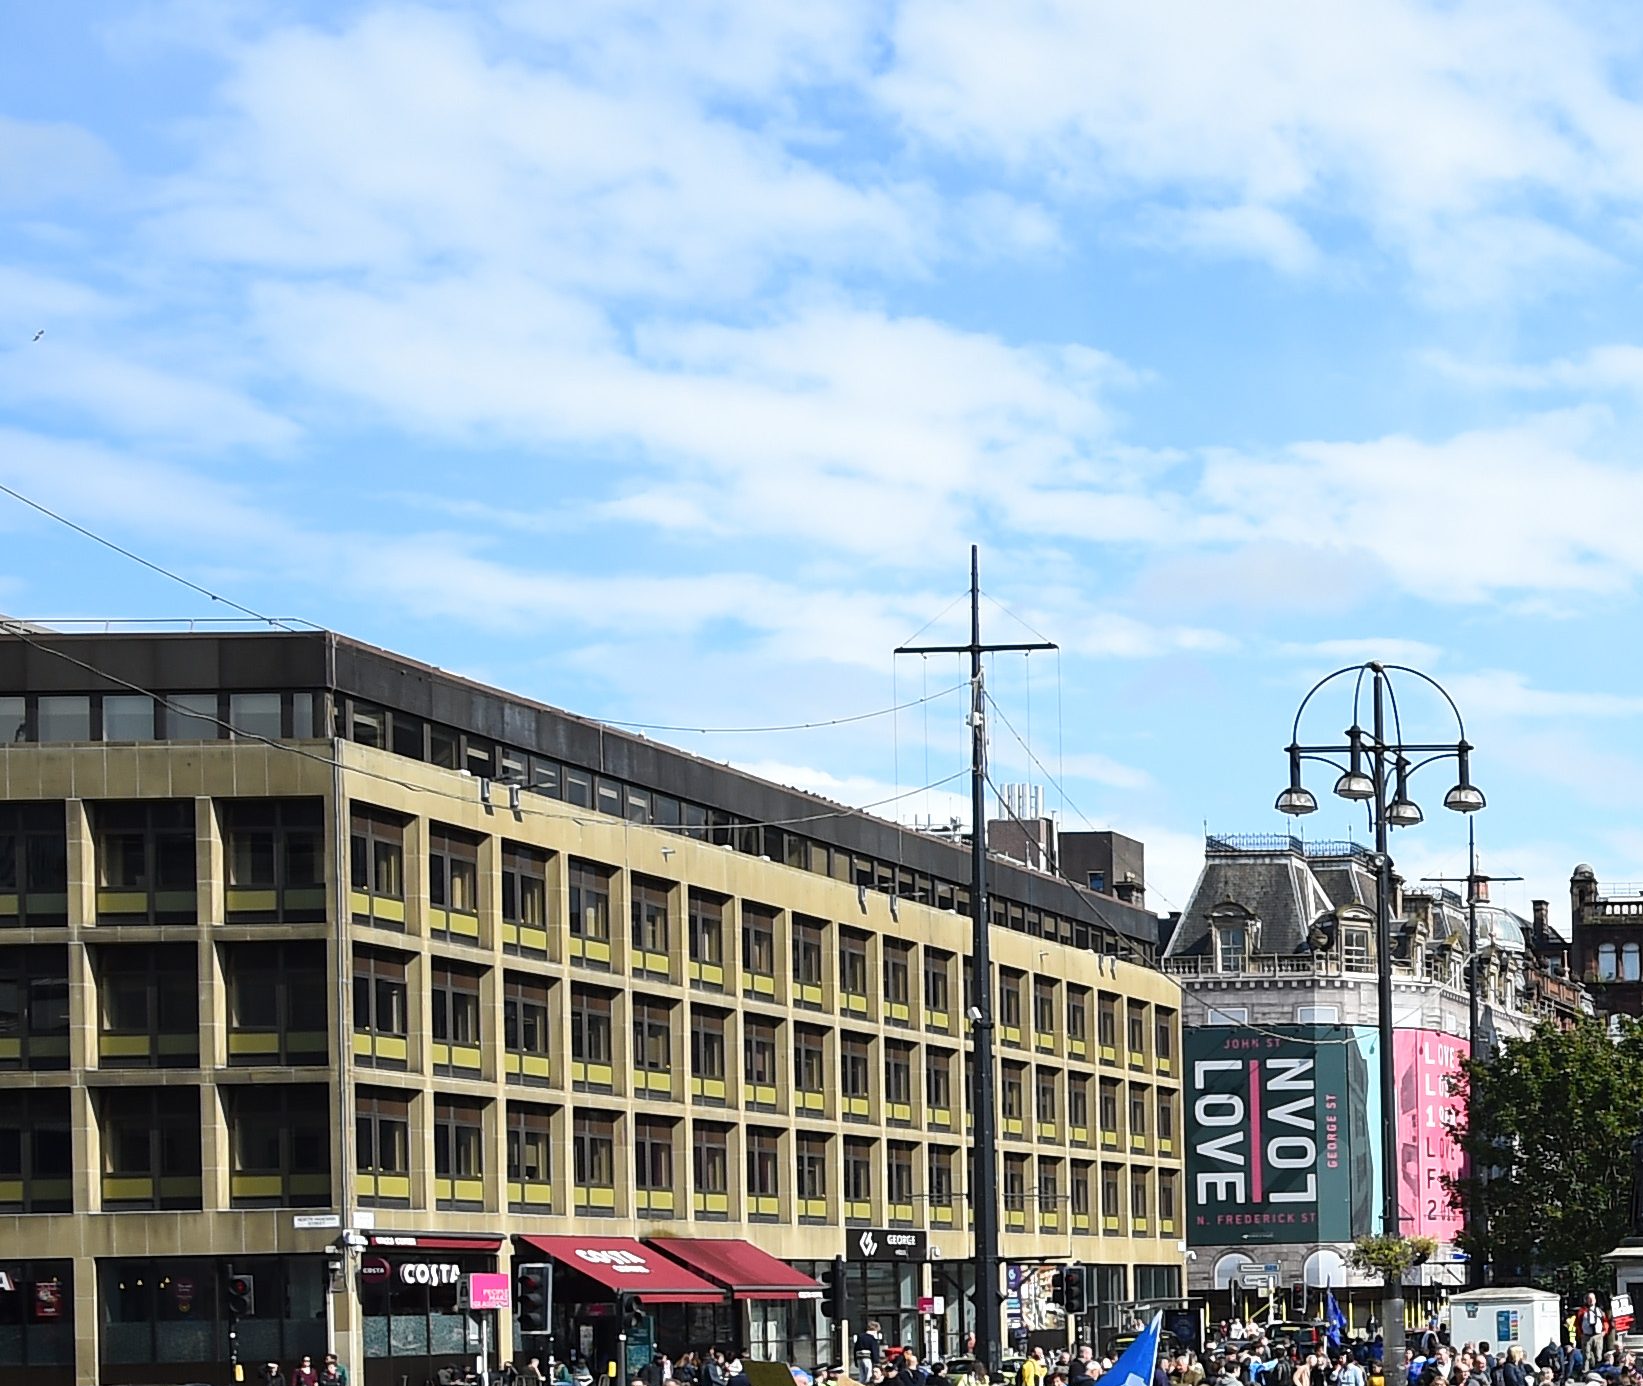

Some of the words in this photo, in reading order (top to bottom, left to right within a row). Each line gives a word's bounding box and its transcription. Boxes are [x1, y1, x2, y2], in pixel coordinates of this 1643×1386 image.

[1224, 1038, 1260, 1050] JOHN
[1266, 1037, 1281, 1049] ST
[1325, 1093, 1338, 1109] ST
[1194, 1059, 1246, 1205] LOVE
[1326, 1115, 1339, 1169] GEORGE
[1196, 1214, 1211, 1226] N.
[1217, 1212, 1296, 1225] FREDERICK
[1301, 1212, 1317, 1224] ST
[886, 1234, 917, 1246] GEORGE
[574, 1249, 647, 1265] COSTA
[362, 1266, 385, 1275] COSTA
[403, 1263, 461, 1287] COSTA
